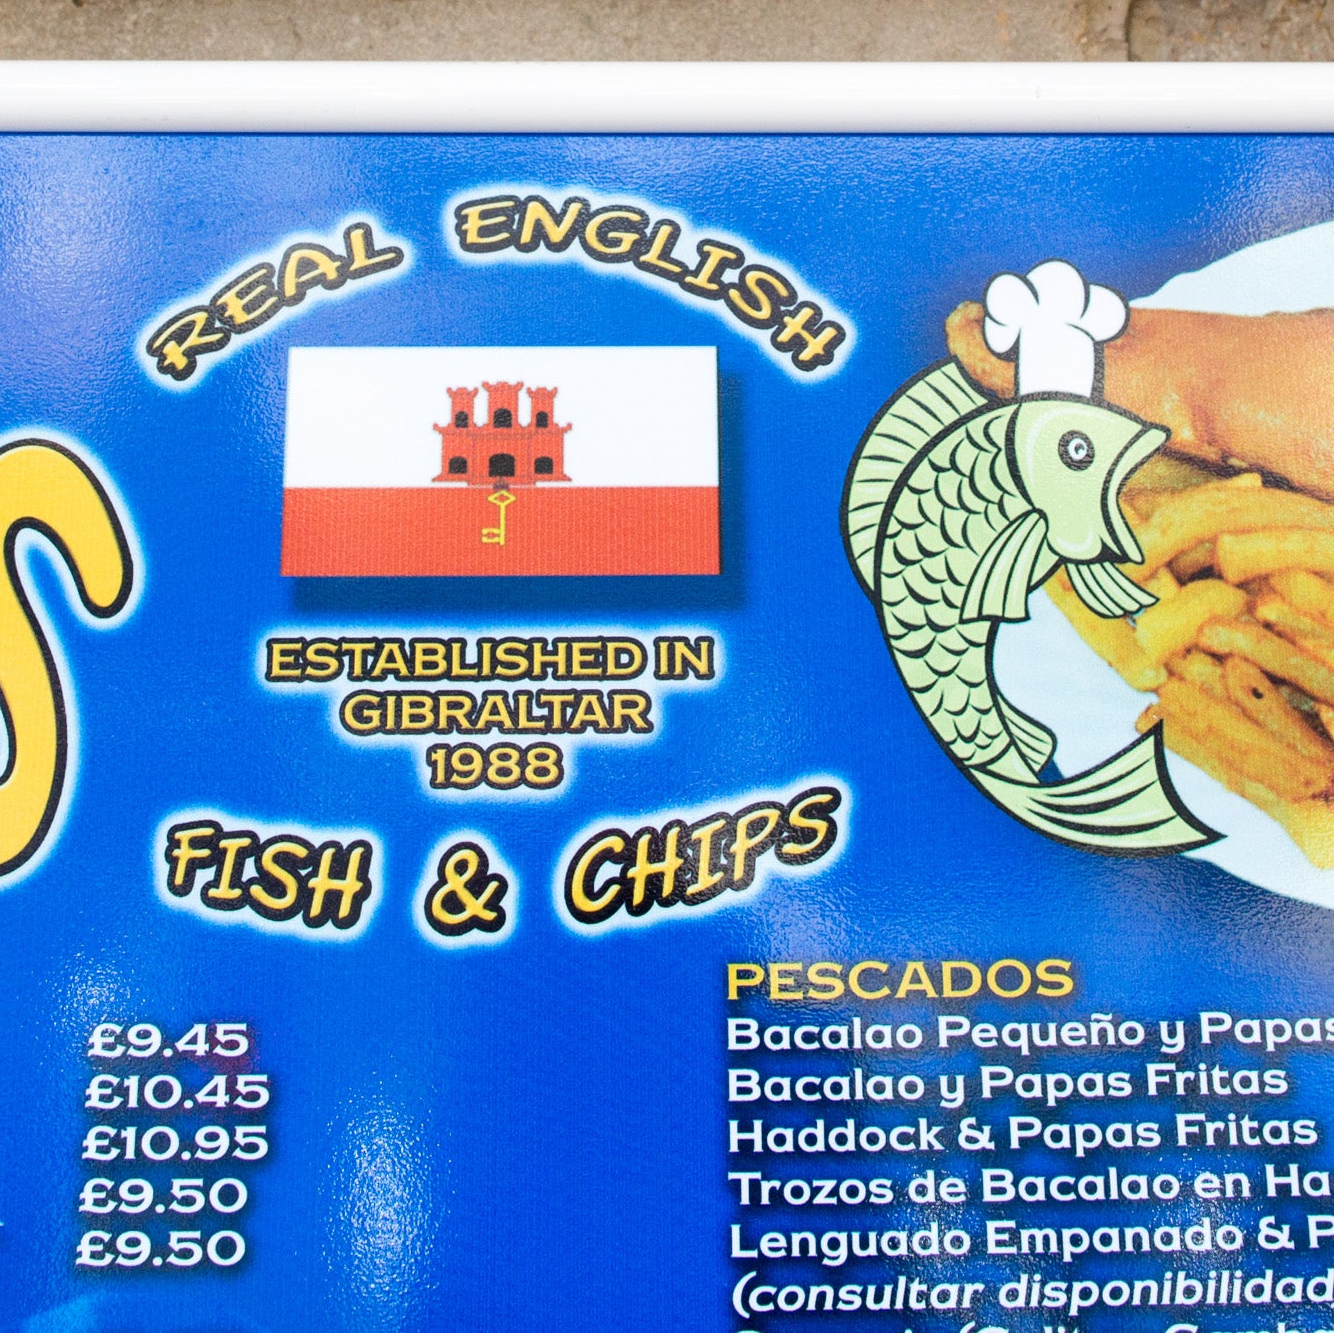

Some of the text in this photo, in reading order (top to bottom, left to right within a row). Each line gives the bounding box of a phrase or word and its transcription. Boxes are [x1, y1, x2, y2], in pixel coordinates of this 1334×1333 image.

[146, 195, 848, 380] REAL ENGLISH
[266, 635, 713, 682] ESTABLISHED IN
[340, 690, 652, 735] GIBRALTAR
[427, 743, 563, 789] 1988
[167, 787, 842, 932] FISH & CHIPS
[728, 959, 1074, 1001] PESCADOS
[87, 1023, 249, 1060] £9.45
[728, 1017, 923, 1051] Bacalao
[937, 1013, 1145, 1056] Pequeño
[1159, 1021, 1185, 1054] y
[84, 1074, 270, 1110] £10.45
[728, 1063, 1288, 1109] Bacalao y Papas Fritas
[81, 1125, 268, 1161] £10.95
[729, 1113, 1318, 1157] Haddock & Papas Fritas
[78, 1178, 248, 1214] £9.50
[728, 1172, 894, 1205] Trozos
[908, 1170, 967, 1204] de
[982, 1167, 1180, 1202] Bacalao
[1193, 1171, 1251, 1199] en
[75, 1230, 246, 1267] £9.50
[731, 1221, 972, 1267] Lenguado
[986, 1216, 1244, 1263] Empanado
[1257, 1216, 1295, 1250] &
[732, 1271, 985, 1319] (consultar
